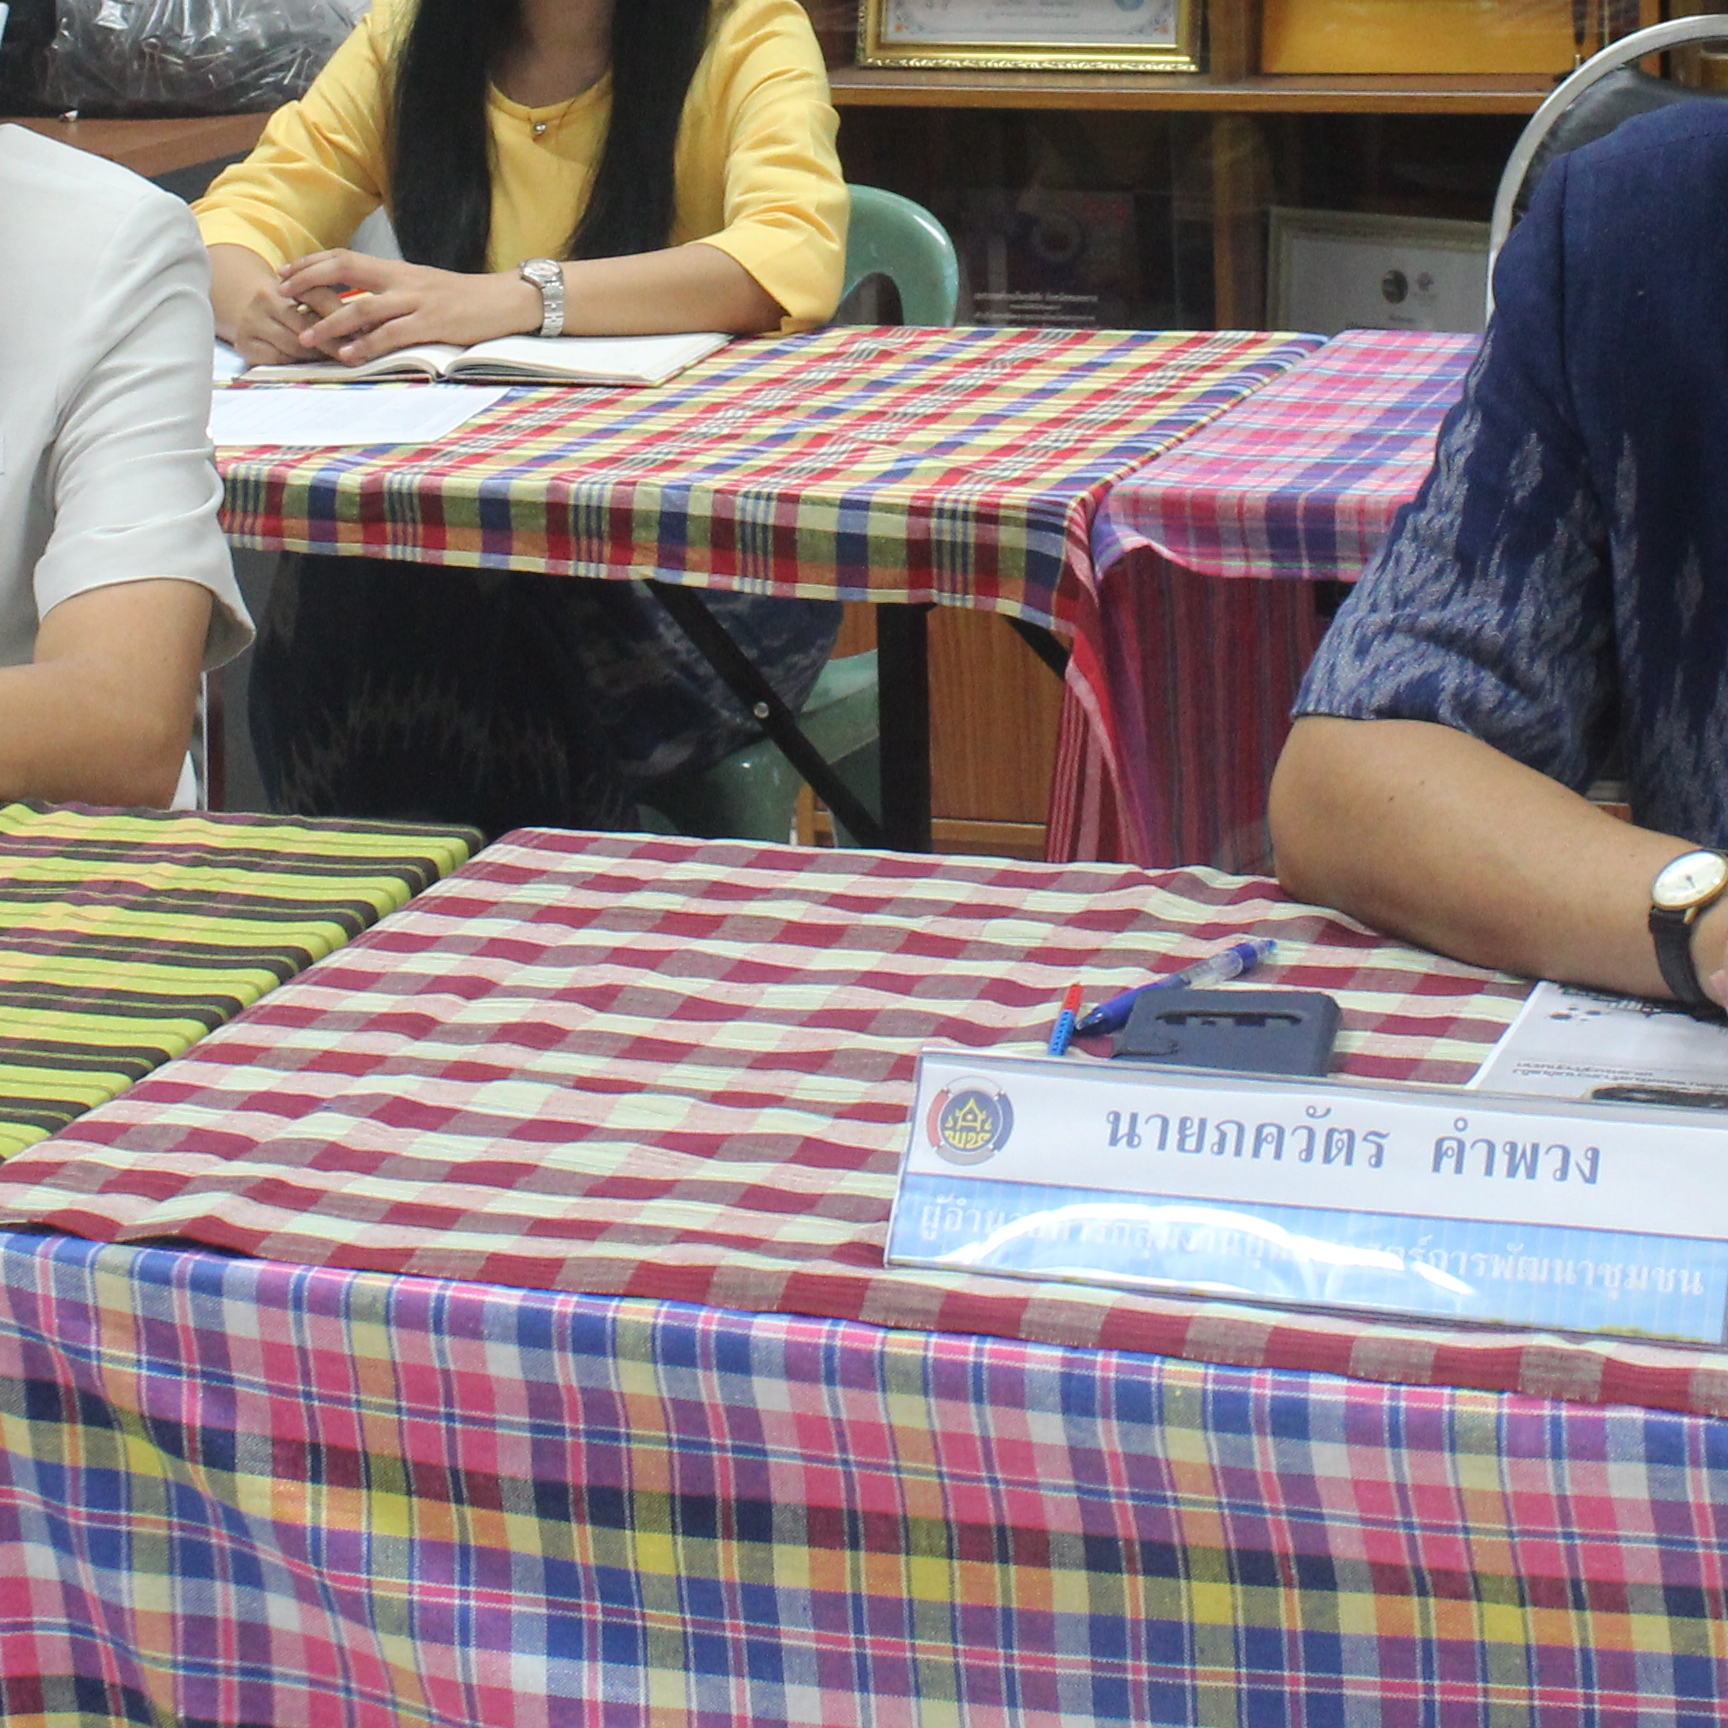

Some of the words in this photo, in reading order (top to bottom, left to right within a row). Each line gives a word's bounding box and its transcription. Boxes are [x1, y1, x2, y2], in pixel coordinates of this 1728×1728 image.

[1106, 1106, 1390, 1170] นายภควัตร
[1431, 1118, 1601, 1185] คำพวง
